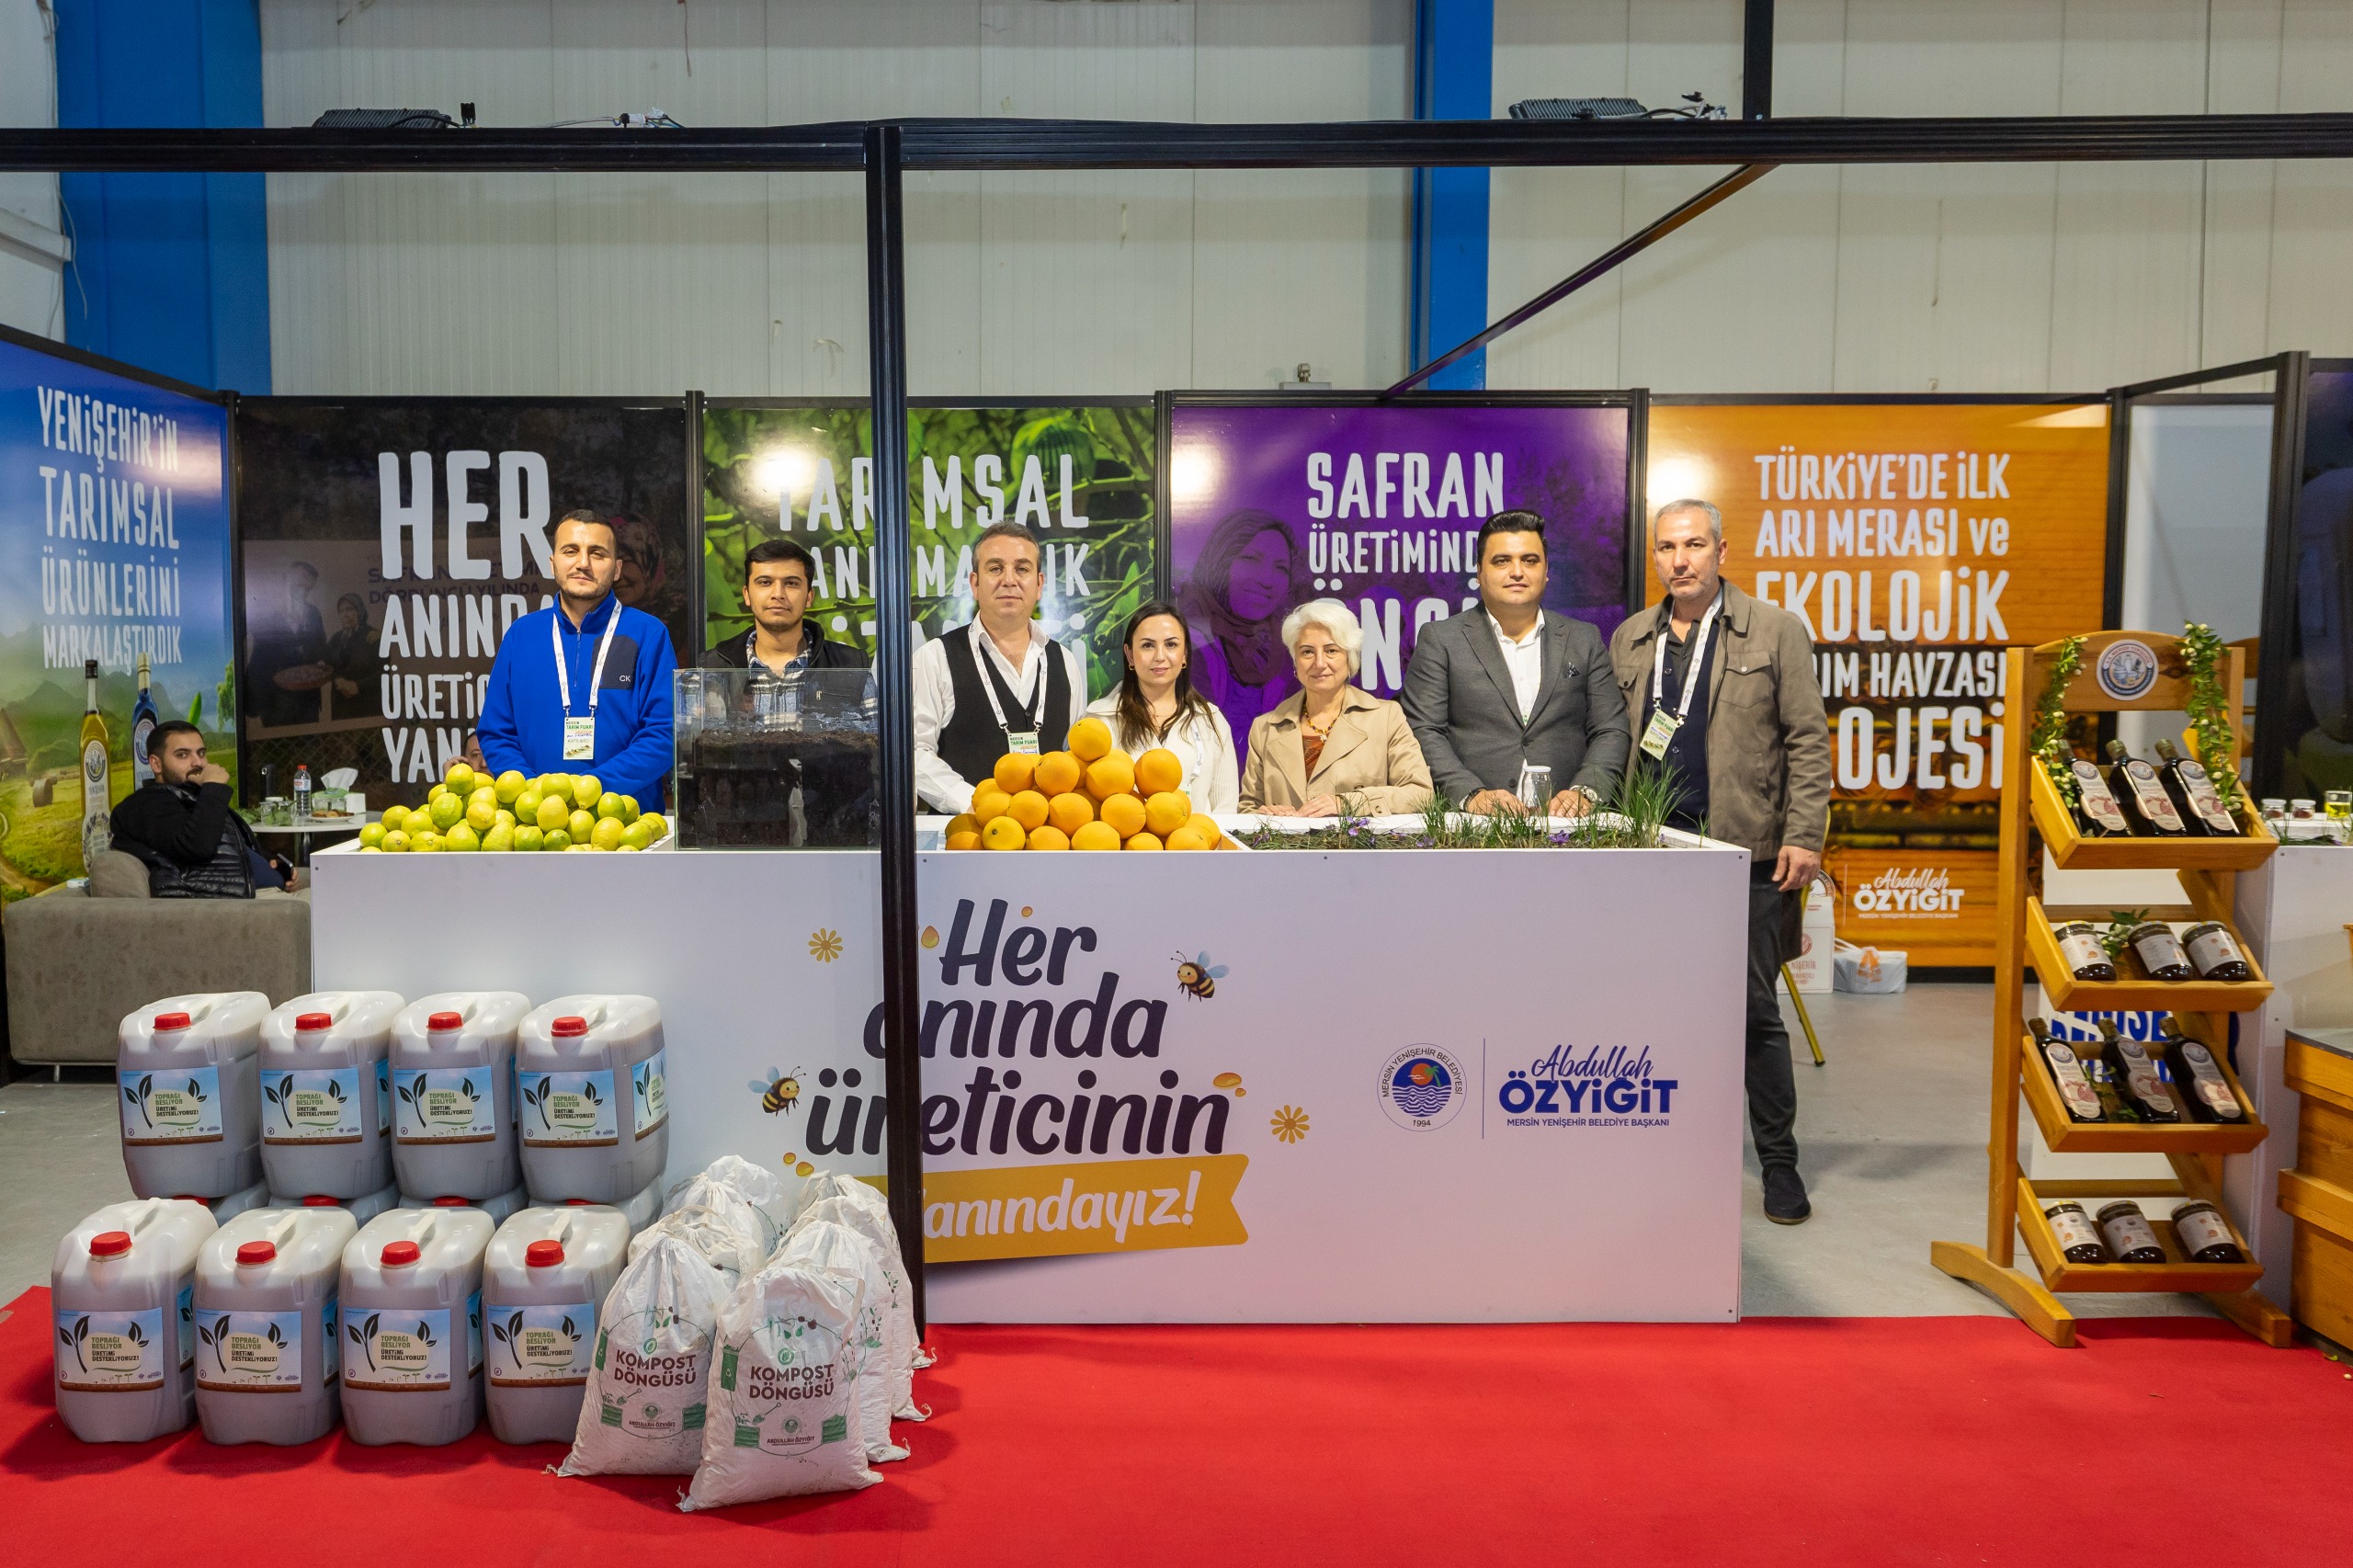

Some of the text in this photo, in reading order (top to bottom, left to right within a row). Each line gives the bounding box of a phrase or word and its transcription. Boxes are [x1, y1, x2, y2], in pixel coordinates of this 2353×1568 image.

[770, 454, 1089, 531] TARMSAL
[1307, 452, 1504, 518] SAFRAN
[1957, 450, 2010, 499] İLK
[40, 466, 180, 550] TARIMSAL
[378, 450, 554, 580] HER
[1756, 508, 2009, 557] ARI MERASI ve
[1309, 523, 1480, 574] ÜRETİMİND
[41, 545, 180, 617] ÜRÜNLERİNİ
[42, 624, 182, 676] MARKALAŞTIRDIK
[379, 594, 554, 658] ANIN
[1870, 652, 2006, 698] HAVZASI
[1831, 702, 2006, 790] OJESİ
[1873, 868, 1949, 890] Abdullah
[938, 898, 1097, 986] Her
[1381, 1047, 1463, 1097] MERSİN YENİŞEHİR BELEDİYESİ
[1531, 1044, 1654, 1083] Abdullah
[804, 1065, 1231, 1156] üreticinin
[1506, 1117, 1669, 1128] MERSİN YENİŞEHİR BELEDİYE BAŞKANI
[923, 1170, 1202, 1244] anındayız!
[614, 1367, 696, 1387] DÖNGÜSÜ
[616, 1349, 696, 1369] KOMPOST
[750, 1363, 835, 1381] KOMPOST
[749, 1378, 835, 1401] DÖNGÜSÜ
